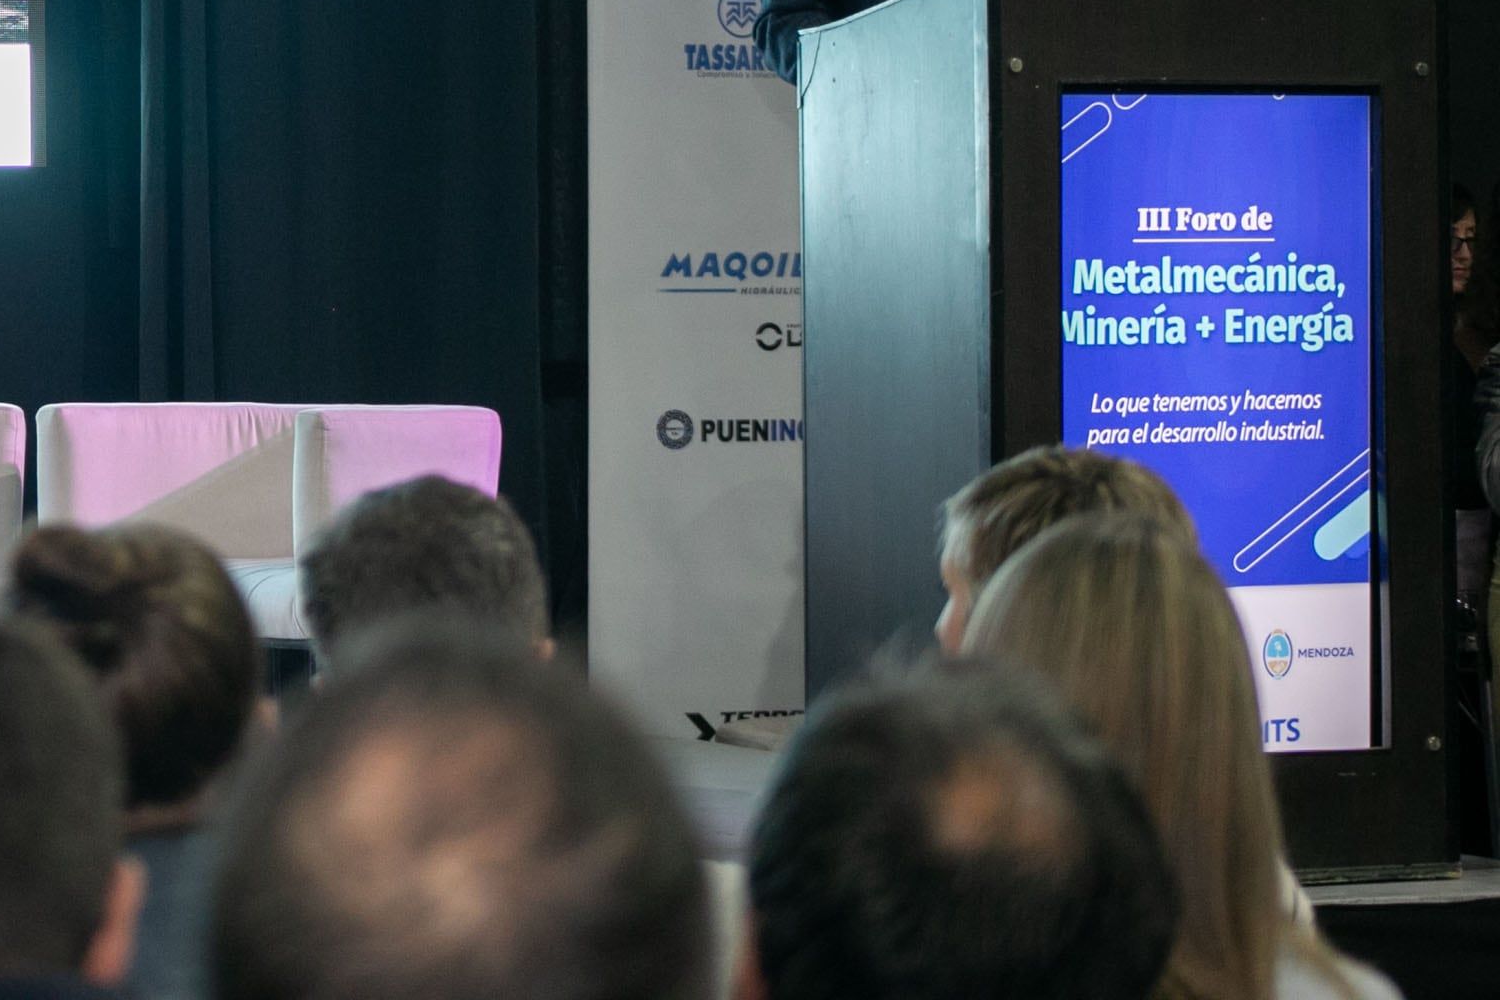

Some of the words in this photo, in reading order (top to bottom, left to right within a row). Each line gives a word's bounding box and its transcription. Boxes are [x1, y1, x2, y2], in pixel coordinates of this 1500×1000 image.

[1137, 207, 1171, 231] III
[1175, 207, 1237, 231] Foro
[1241, 205, 1273, 231] de
[1073, 252, 1345, 298] Metalmecánica,
[1062, 303, 1186, 345] Minería
[1196, 315, 1215, 338] +
[1225, 301, 1354, 352] Energía
[1091, 393, 1113, 414] Lo
[1116, 396, 1149, 417] que
[1153, 393, 1228, 413] tenemos
[1228, 393, 1242, 416] y
[1243, 389, 1322, 411] hacemos
[1086, 426, 1129, 449] para
[1132, 422, 1149, 444] el
[1150, 420, 1237, 442] desarrollo
[1240, 418, 1325, 441] industrial.
[1297, 647, 1355, 659] MENDOZA
